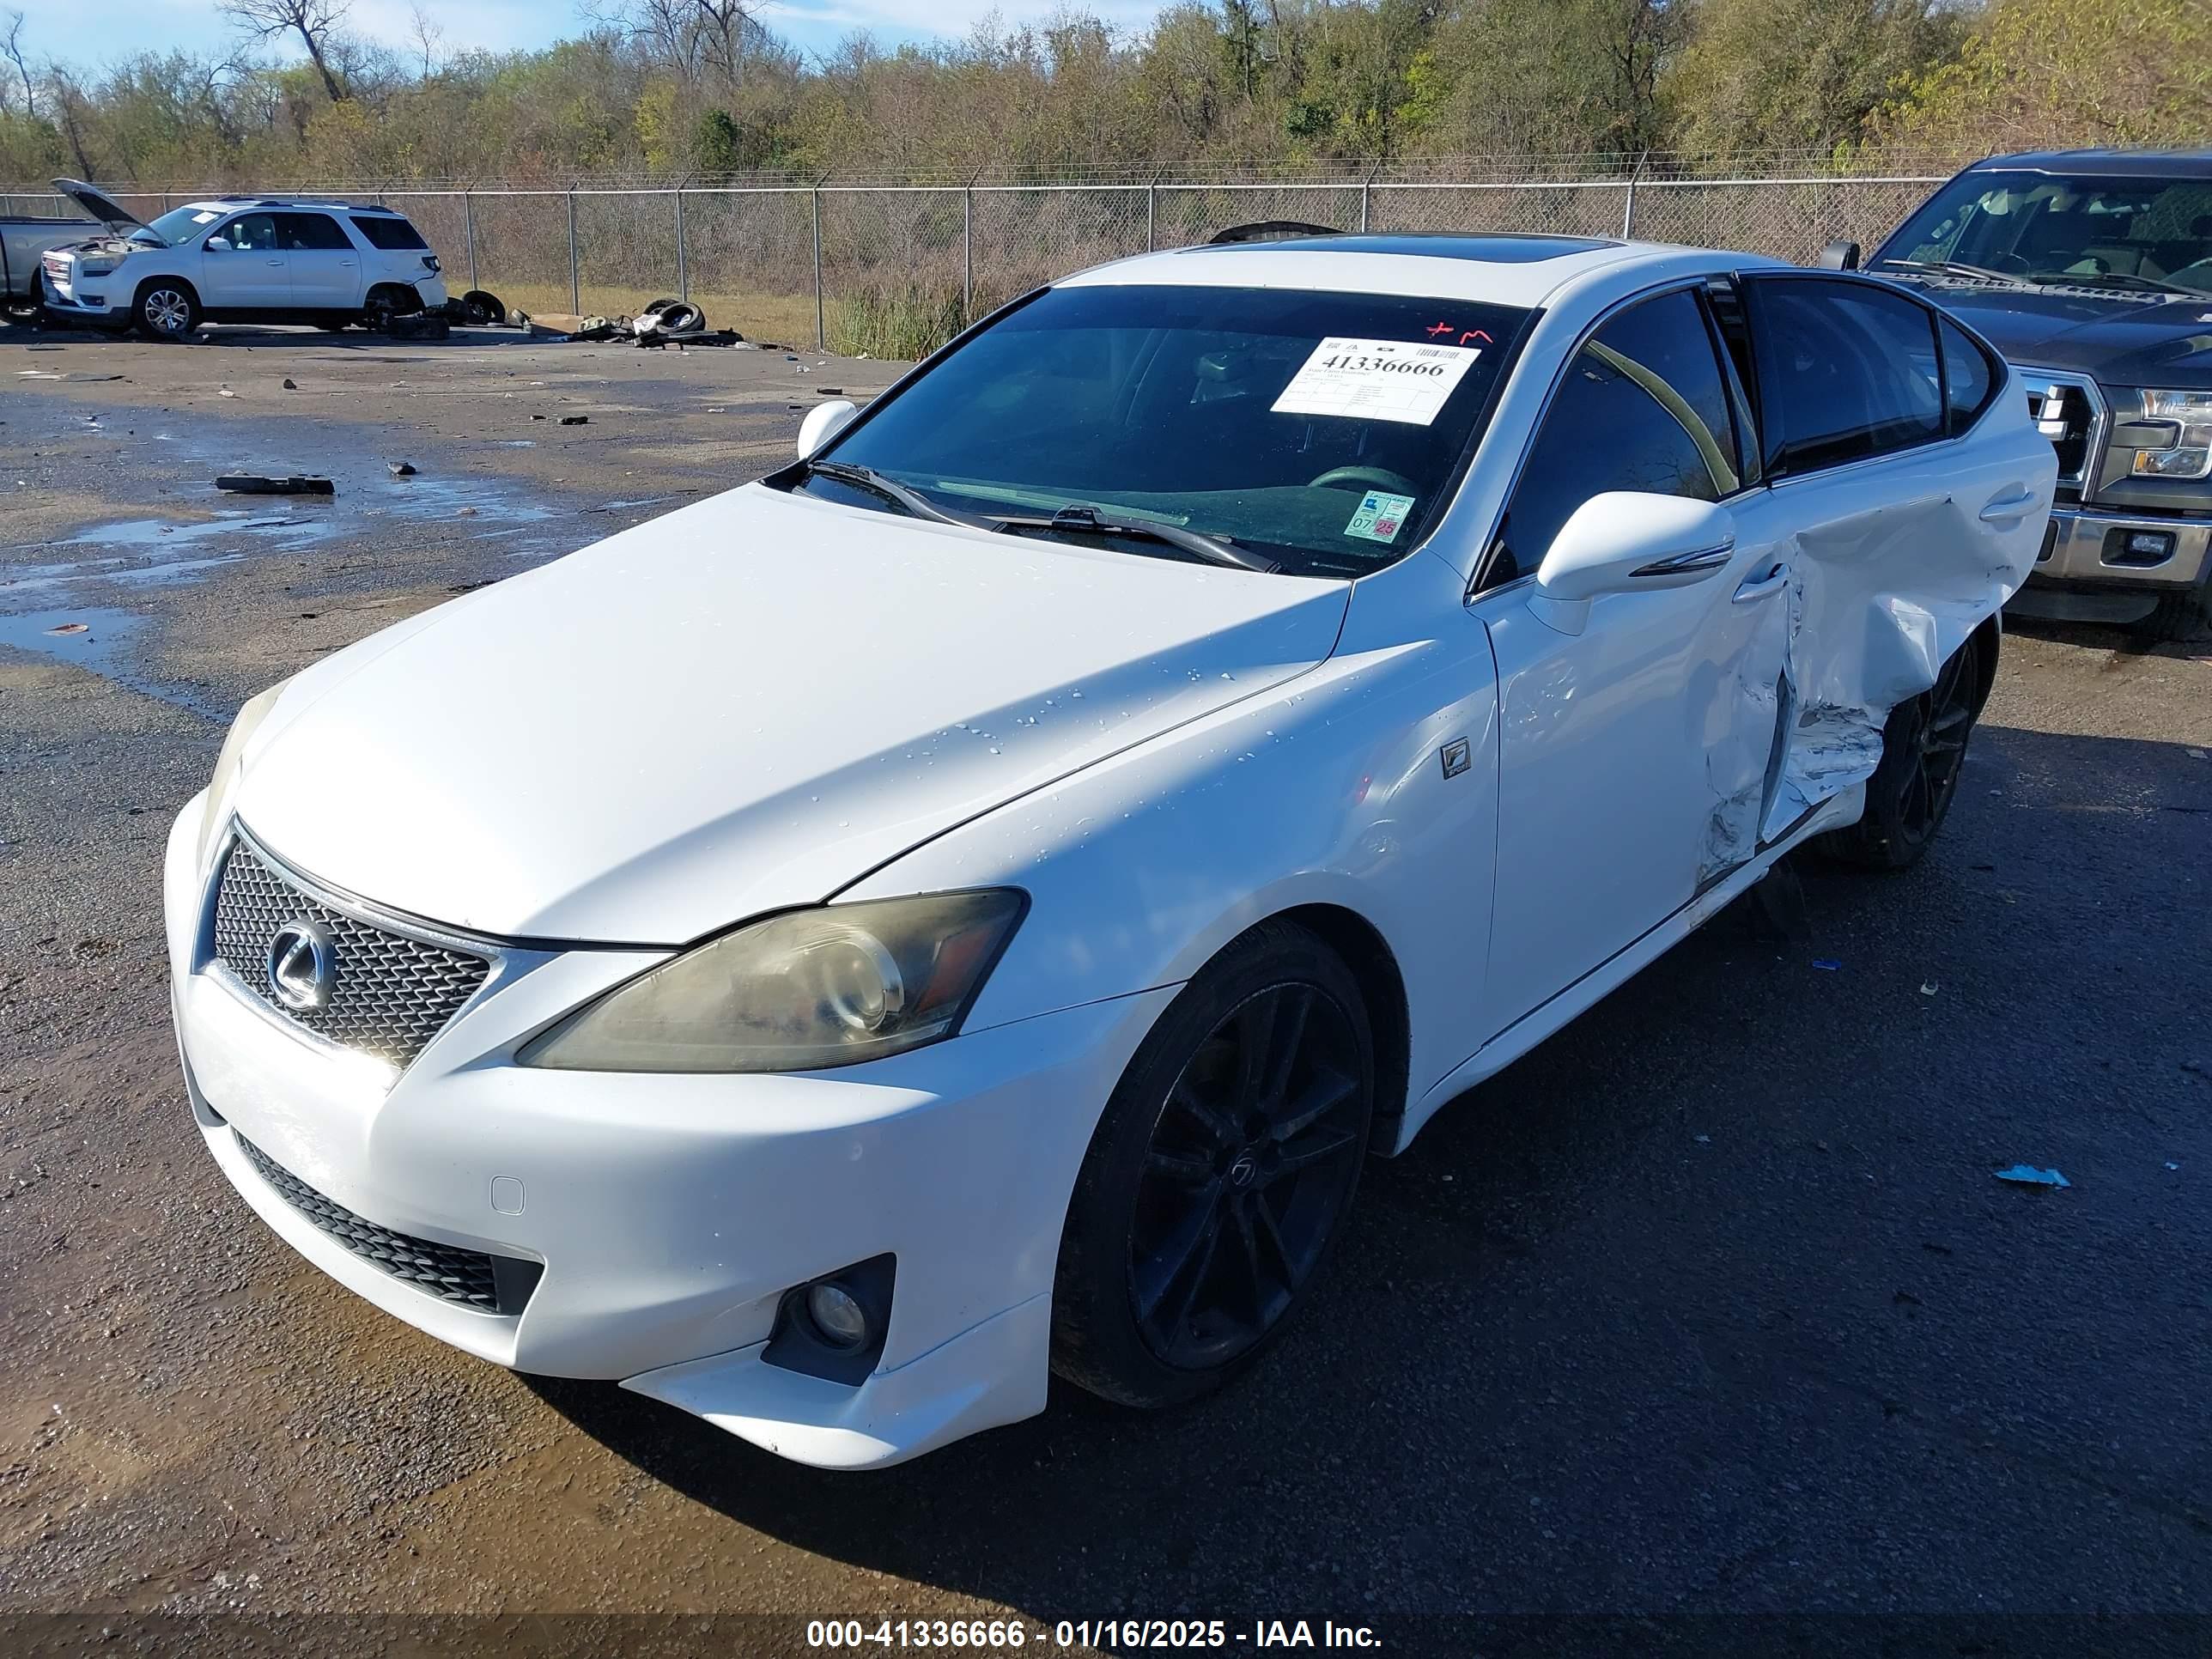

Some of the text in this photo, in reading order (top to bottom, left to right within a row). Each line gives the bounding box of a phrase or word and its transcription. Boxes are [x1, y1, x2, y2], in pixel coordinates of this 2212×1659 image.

[1322, 355, 1449, 377] 41336666
[1352, 518, 1372, 529] 07
[1376, 522, 1395, 533] 25
